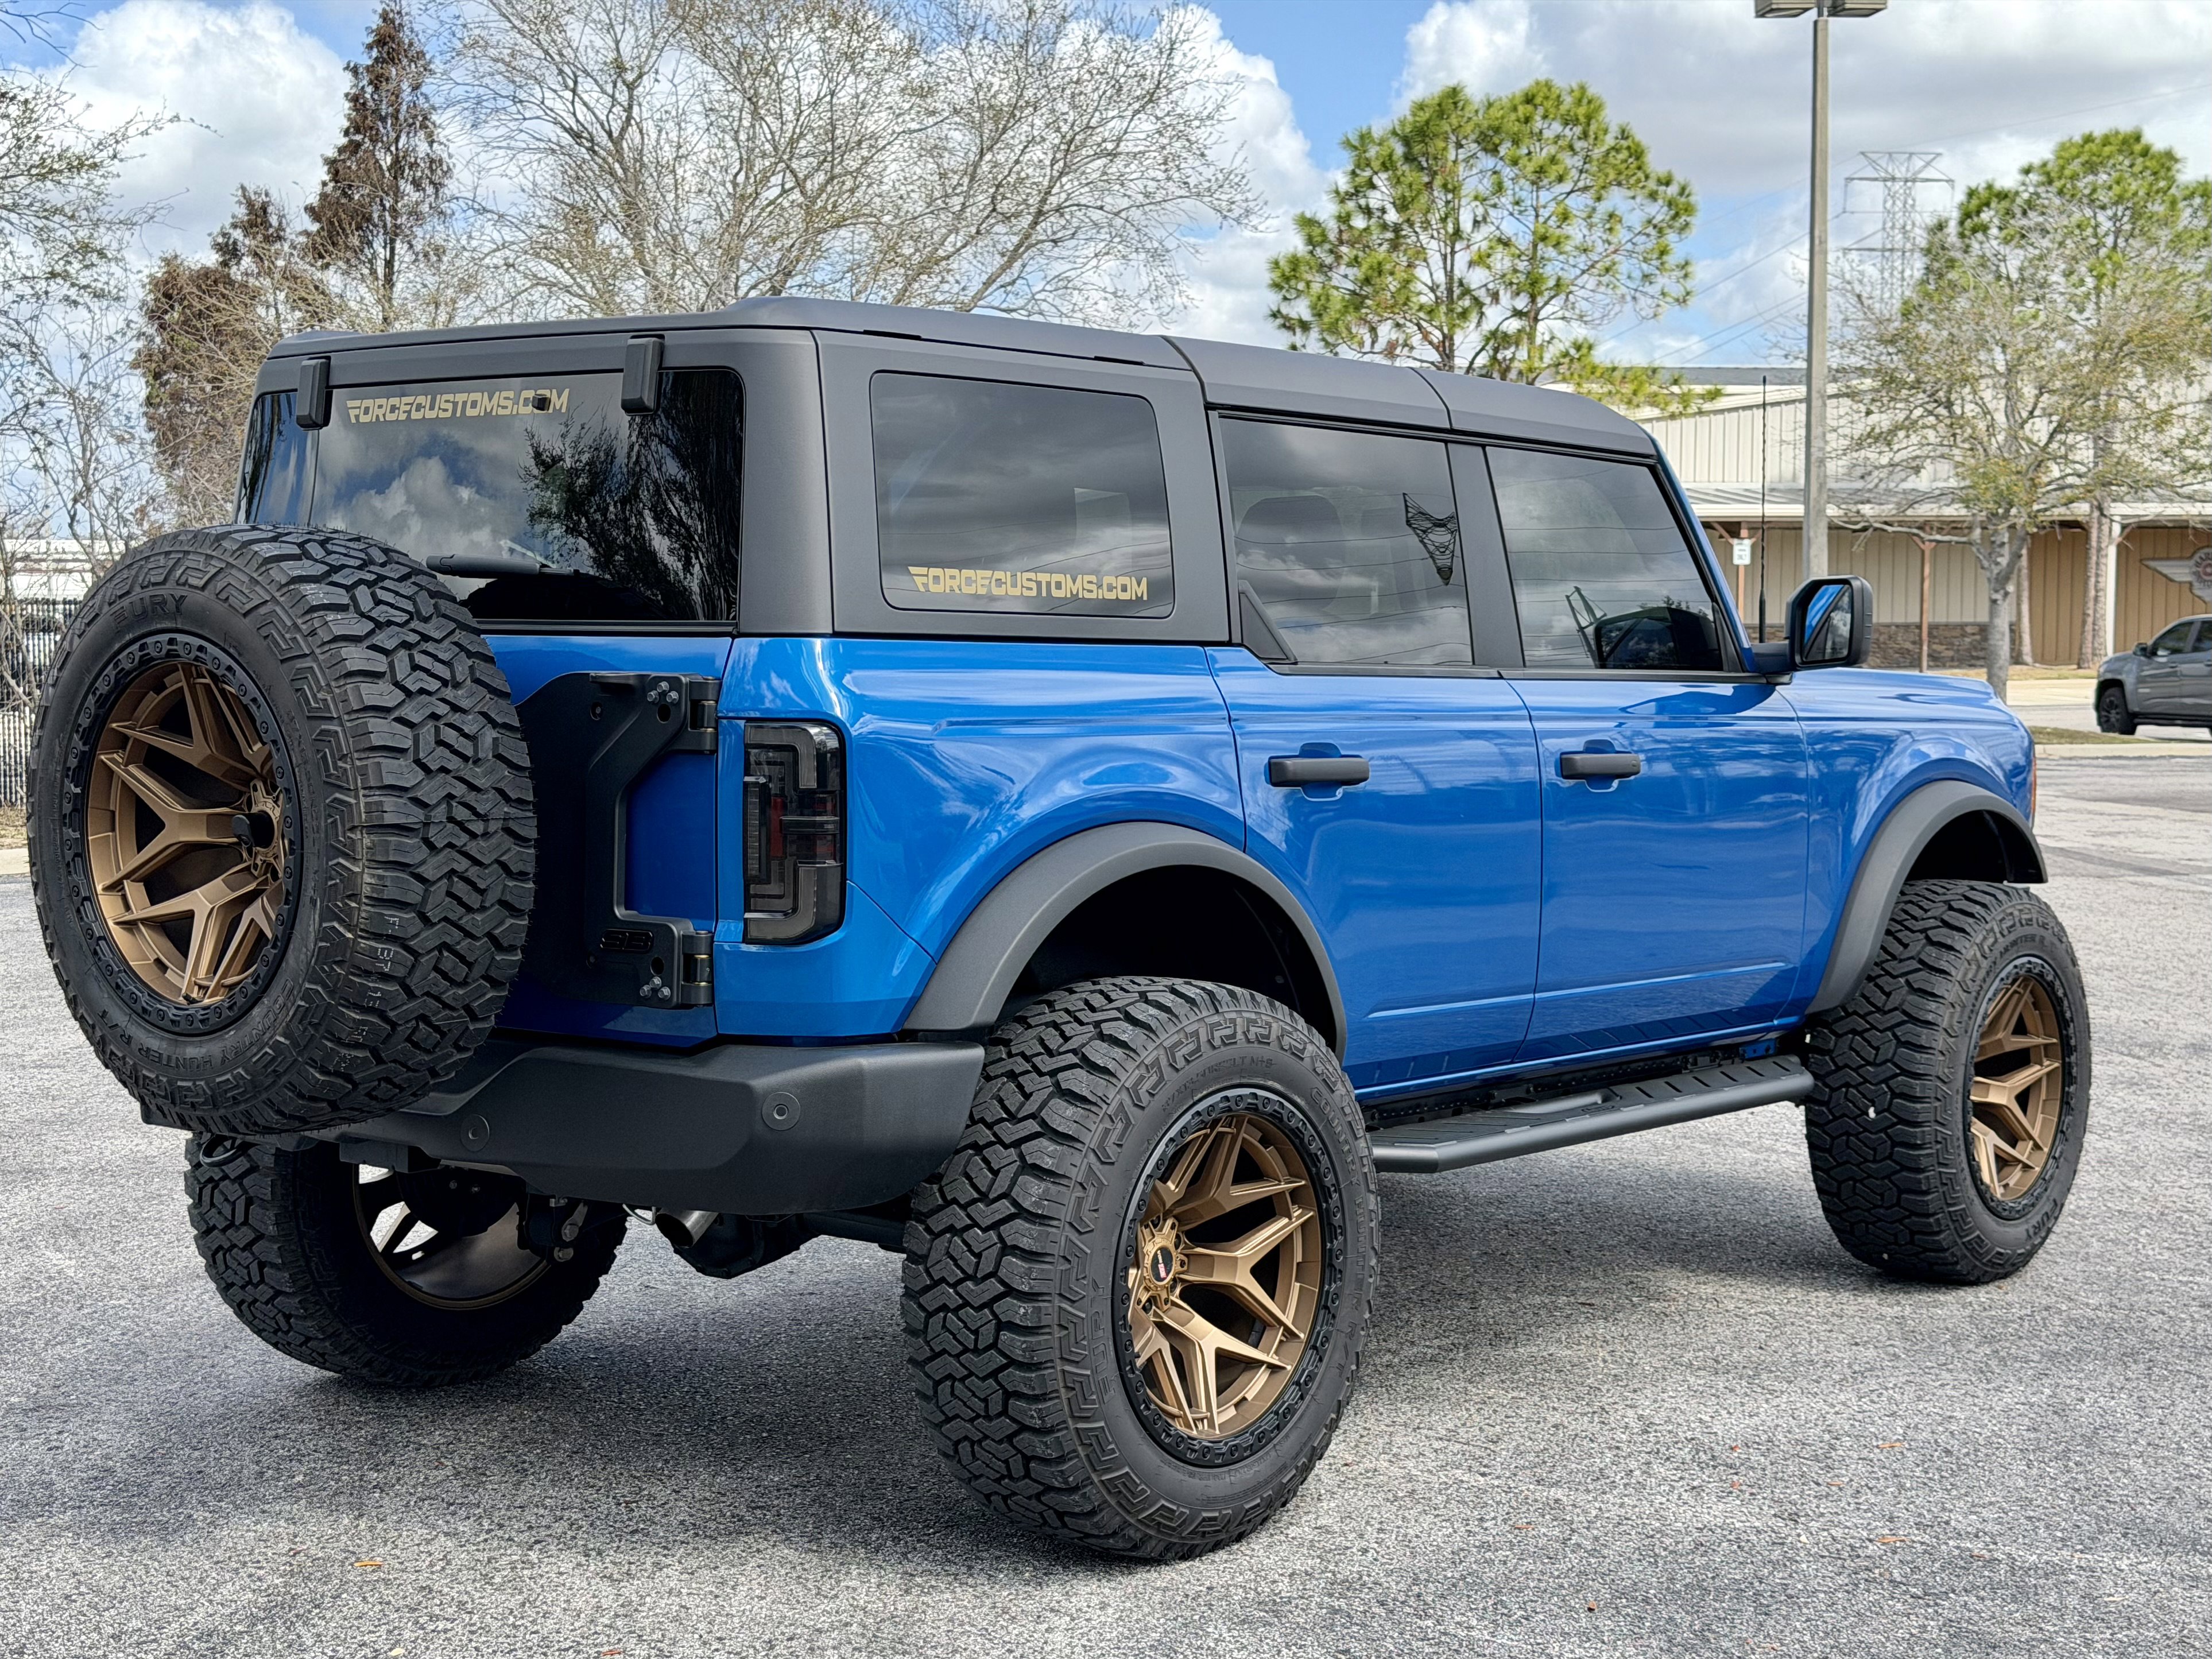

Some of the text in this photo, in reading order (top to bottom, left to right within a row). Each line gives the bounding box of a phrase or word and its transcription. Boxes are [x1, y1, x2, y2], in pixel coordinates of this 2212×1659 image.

[110, 593, 188, 629] FURY
[908, 566, 1148, 600] FORCECUSTOMS.COM
[220, 978, 294, 1065] COUNTRY
[138, 1042, 214, 1072] HUNTER
[1311, 1087, 1361, 1187] COUNTRY
[1353, 1196, 1366, 1312] HUNTER
[1090, 1277, 1117, 1405] FURY
